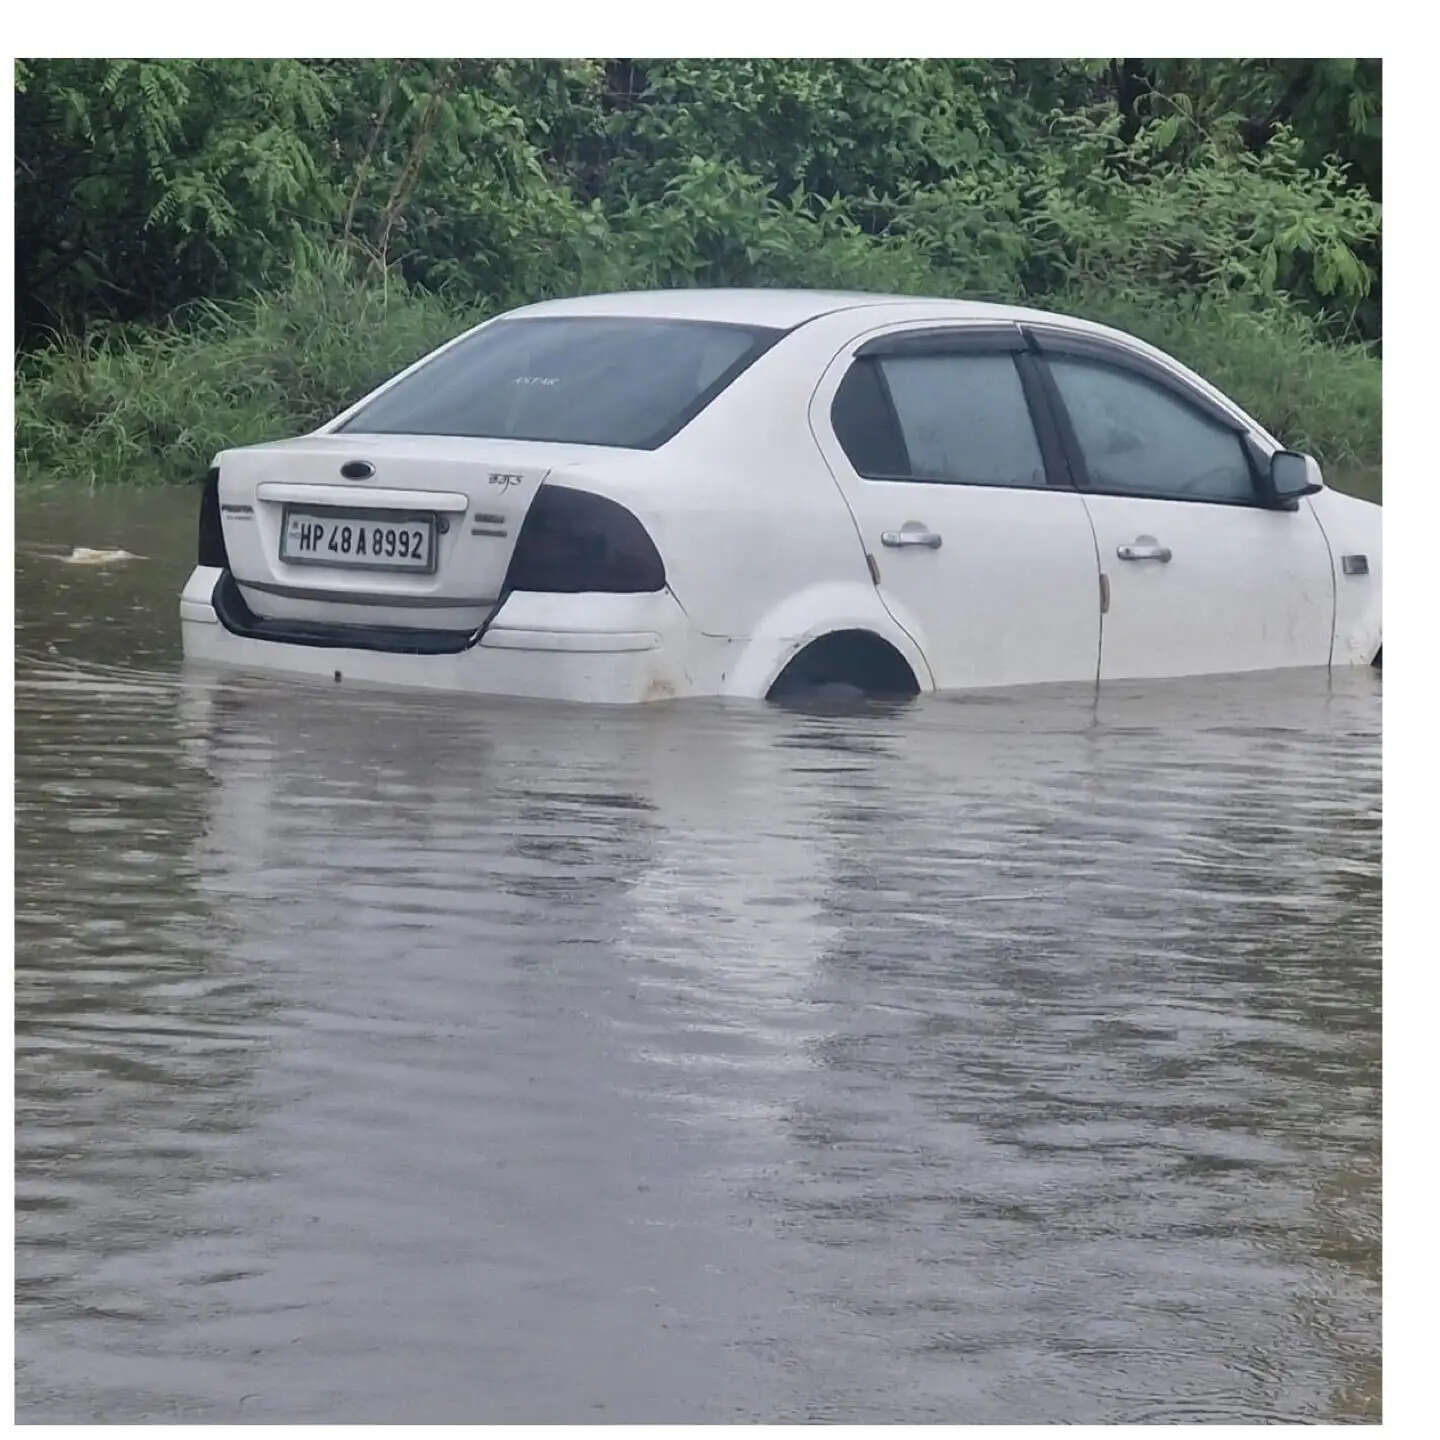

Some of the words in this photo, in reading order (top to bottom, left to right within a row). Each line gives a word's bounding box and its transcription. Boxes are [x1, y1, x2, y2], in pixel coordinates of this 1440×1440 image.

[300, 523, 324, 551] HP
[328, 525, 352, 553] 48
[356, 528, 367, 555] A
[372, 528, 423, 559] 8992
